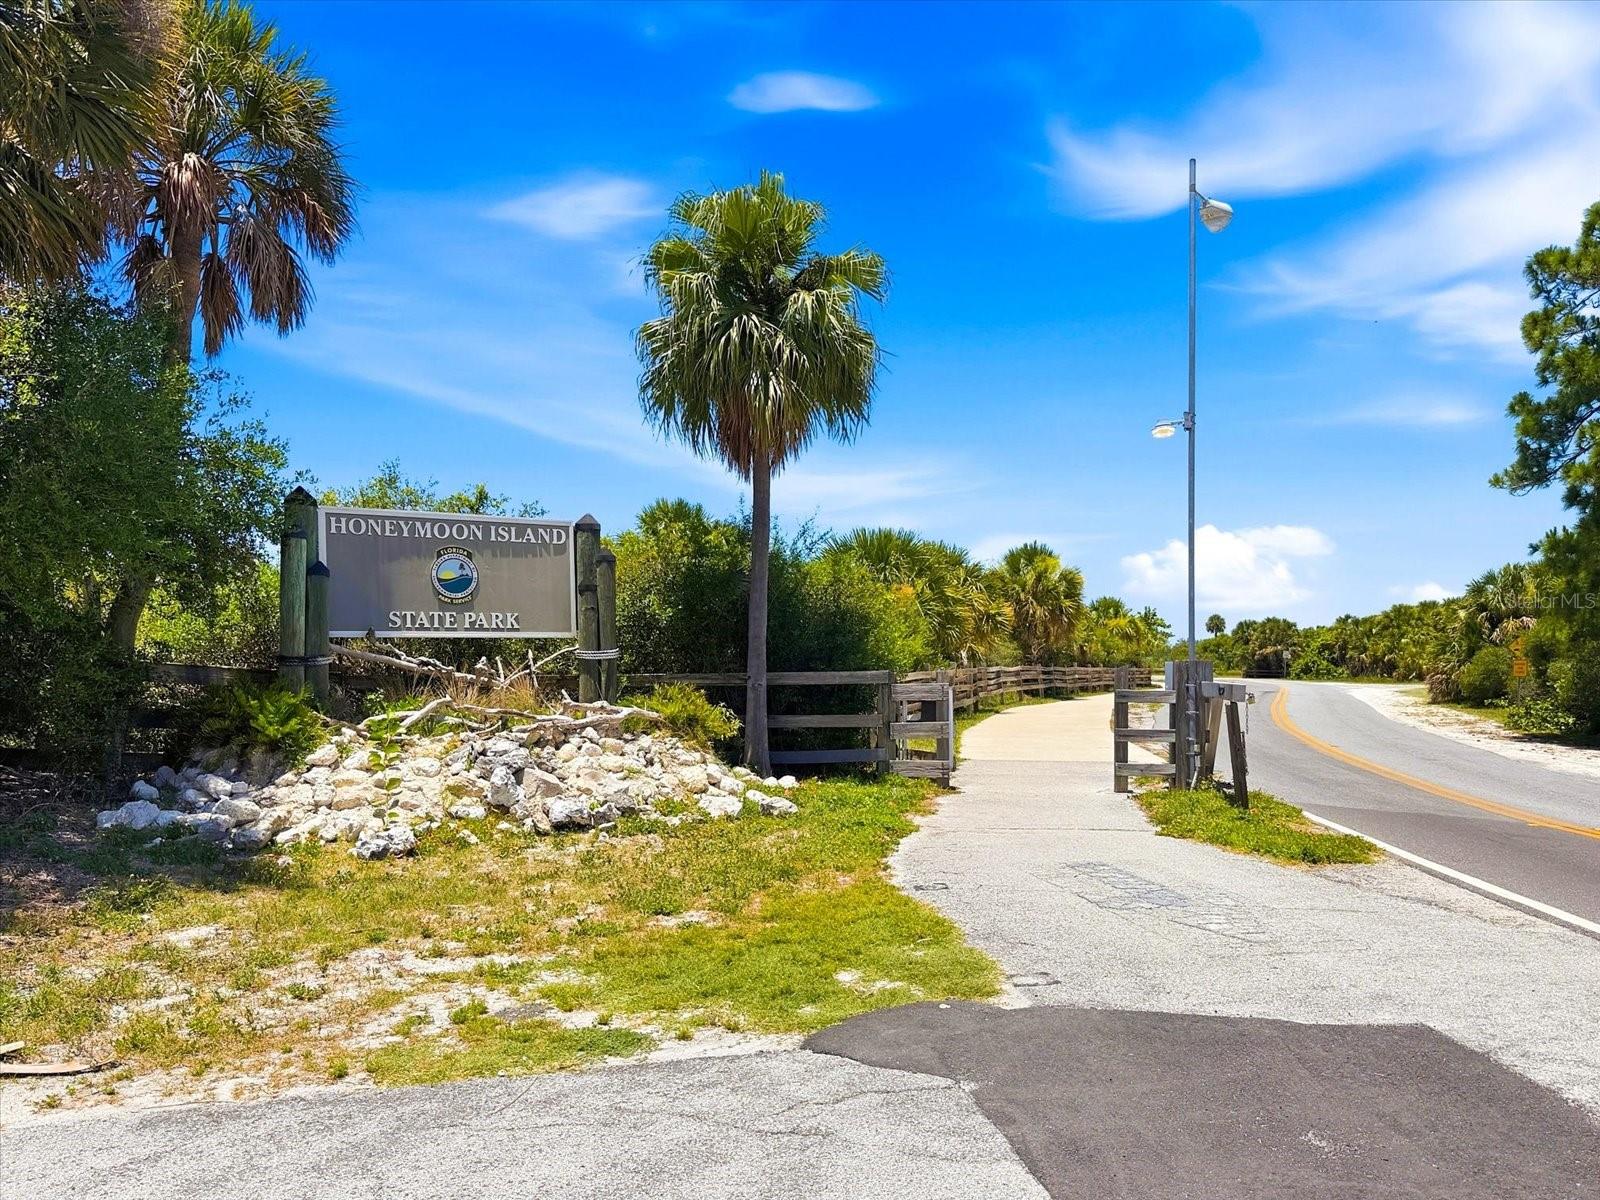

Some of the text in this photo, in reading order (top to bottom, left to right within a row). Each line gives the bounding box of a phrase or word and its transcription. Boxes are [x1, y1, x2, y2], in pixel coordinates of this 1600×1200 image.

[329, 516, 567, 545] HONEYMOON ISLAND
[440, 547, 468, 556] FLORIDA
[388, 610, 520, 629] STATE PARK
